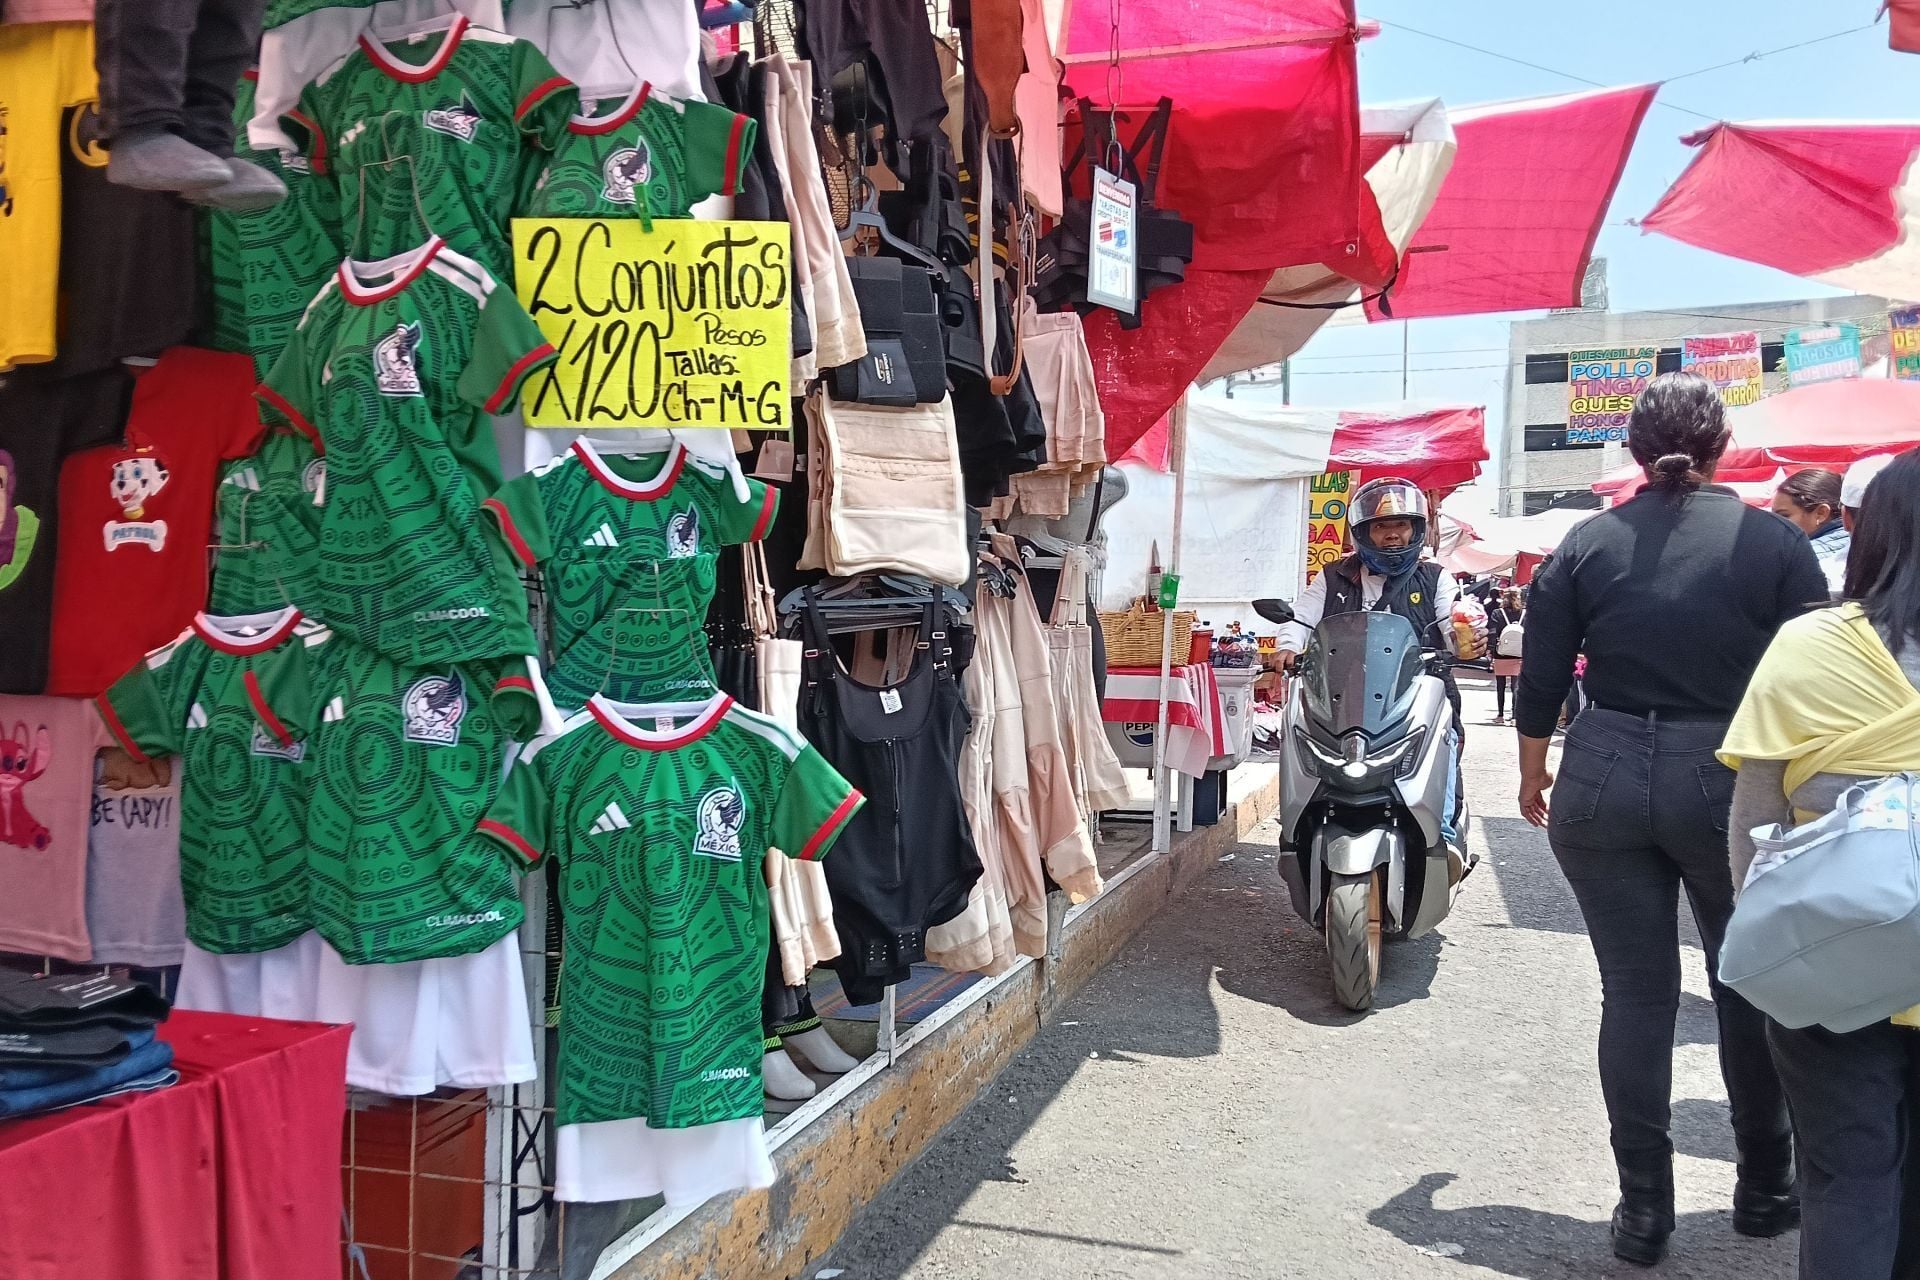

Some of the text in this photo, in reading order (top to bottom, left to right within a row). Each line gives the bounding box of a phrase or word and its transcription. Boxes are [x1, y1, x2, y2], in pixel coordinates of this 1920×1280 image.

[526, 226, 573, 316] 2
[694, 312, 767, 346] Pesos
[1569, 347, 1655, 363] QUESADILLAS
[1792, 344, 1834, 367] TACOS
[1571, 361, 1654, 380] POLLO
[1571, 378, 1647, 397] TINGA
[1719, 379, 1760, 406] HARRÓN
[1571, 395, 1634, 414] QUES
[1567, 427, 1630, 443] PANCI
[1310, 470, 1350, 493] LLAS
[1309, 499, 1347, 520] LO
[1308, 523, 1341, 546] GA
[1307, 547, 1340, 567] SO
[121, 794, 173, 830] CAPY!
[700, 838, 738, 854] MÉXIC
